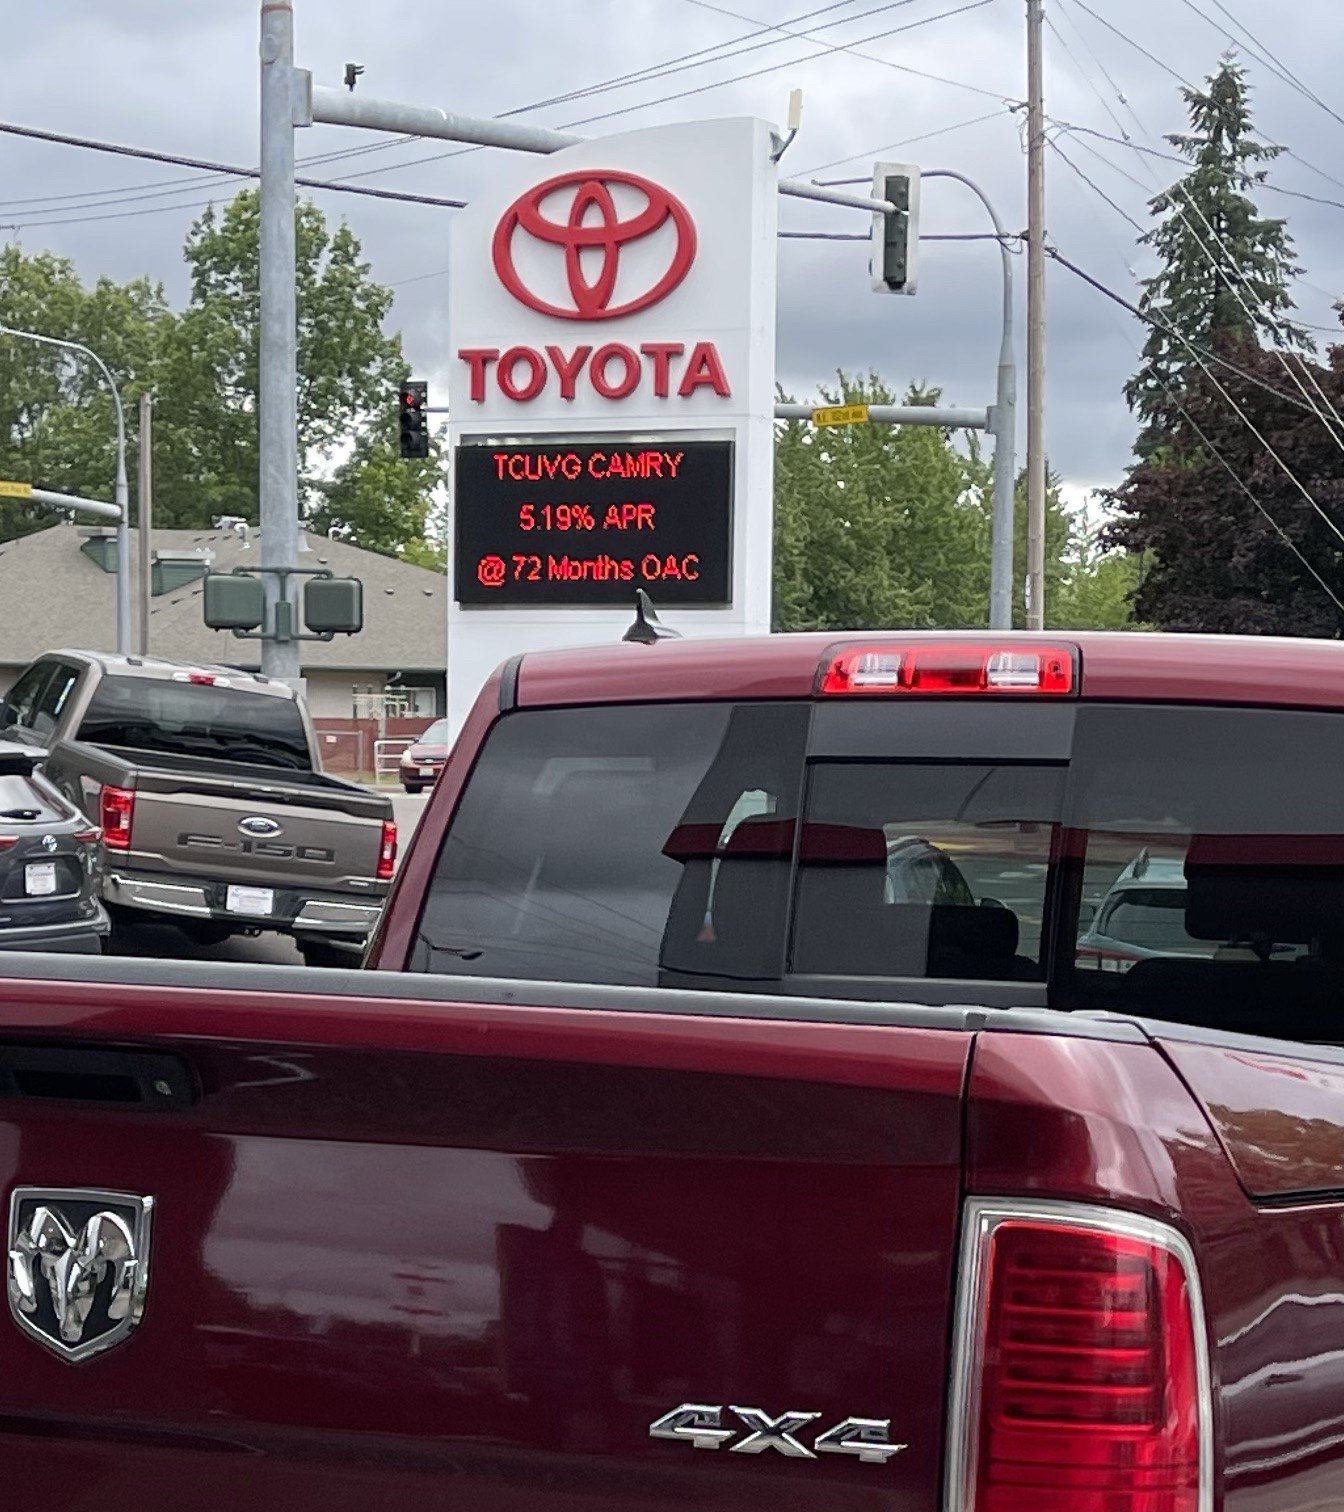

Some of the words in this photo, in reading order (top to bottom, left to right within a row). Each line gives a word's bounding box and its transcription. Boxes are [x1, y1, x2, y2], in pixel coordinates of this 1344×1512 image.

[459, 342, 732, 403] TOYOTA
[588, 451, 685, 479] CAMRY
[519, 504, 595, 531] 5.19%
[604, 504, 657, 531] APR
[477, 555, 506, 586] @
[512, 555, 542, 581] 72
[548, 554, 634, 581] Months
[642, 554, 699, 581] OAC
[177, 833, 336, 865] F-150
